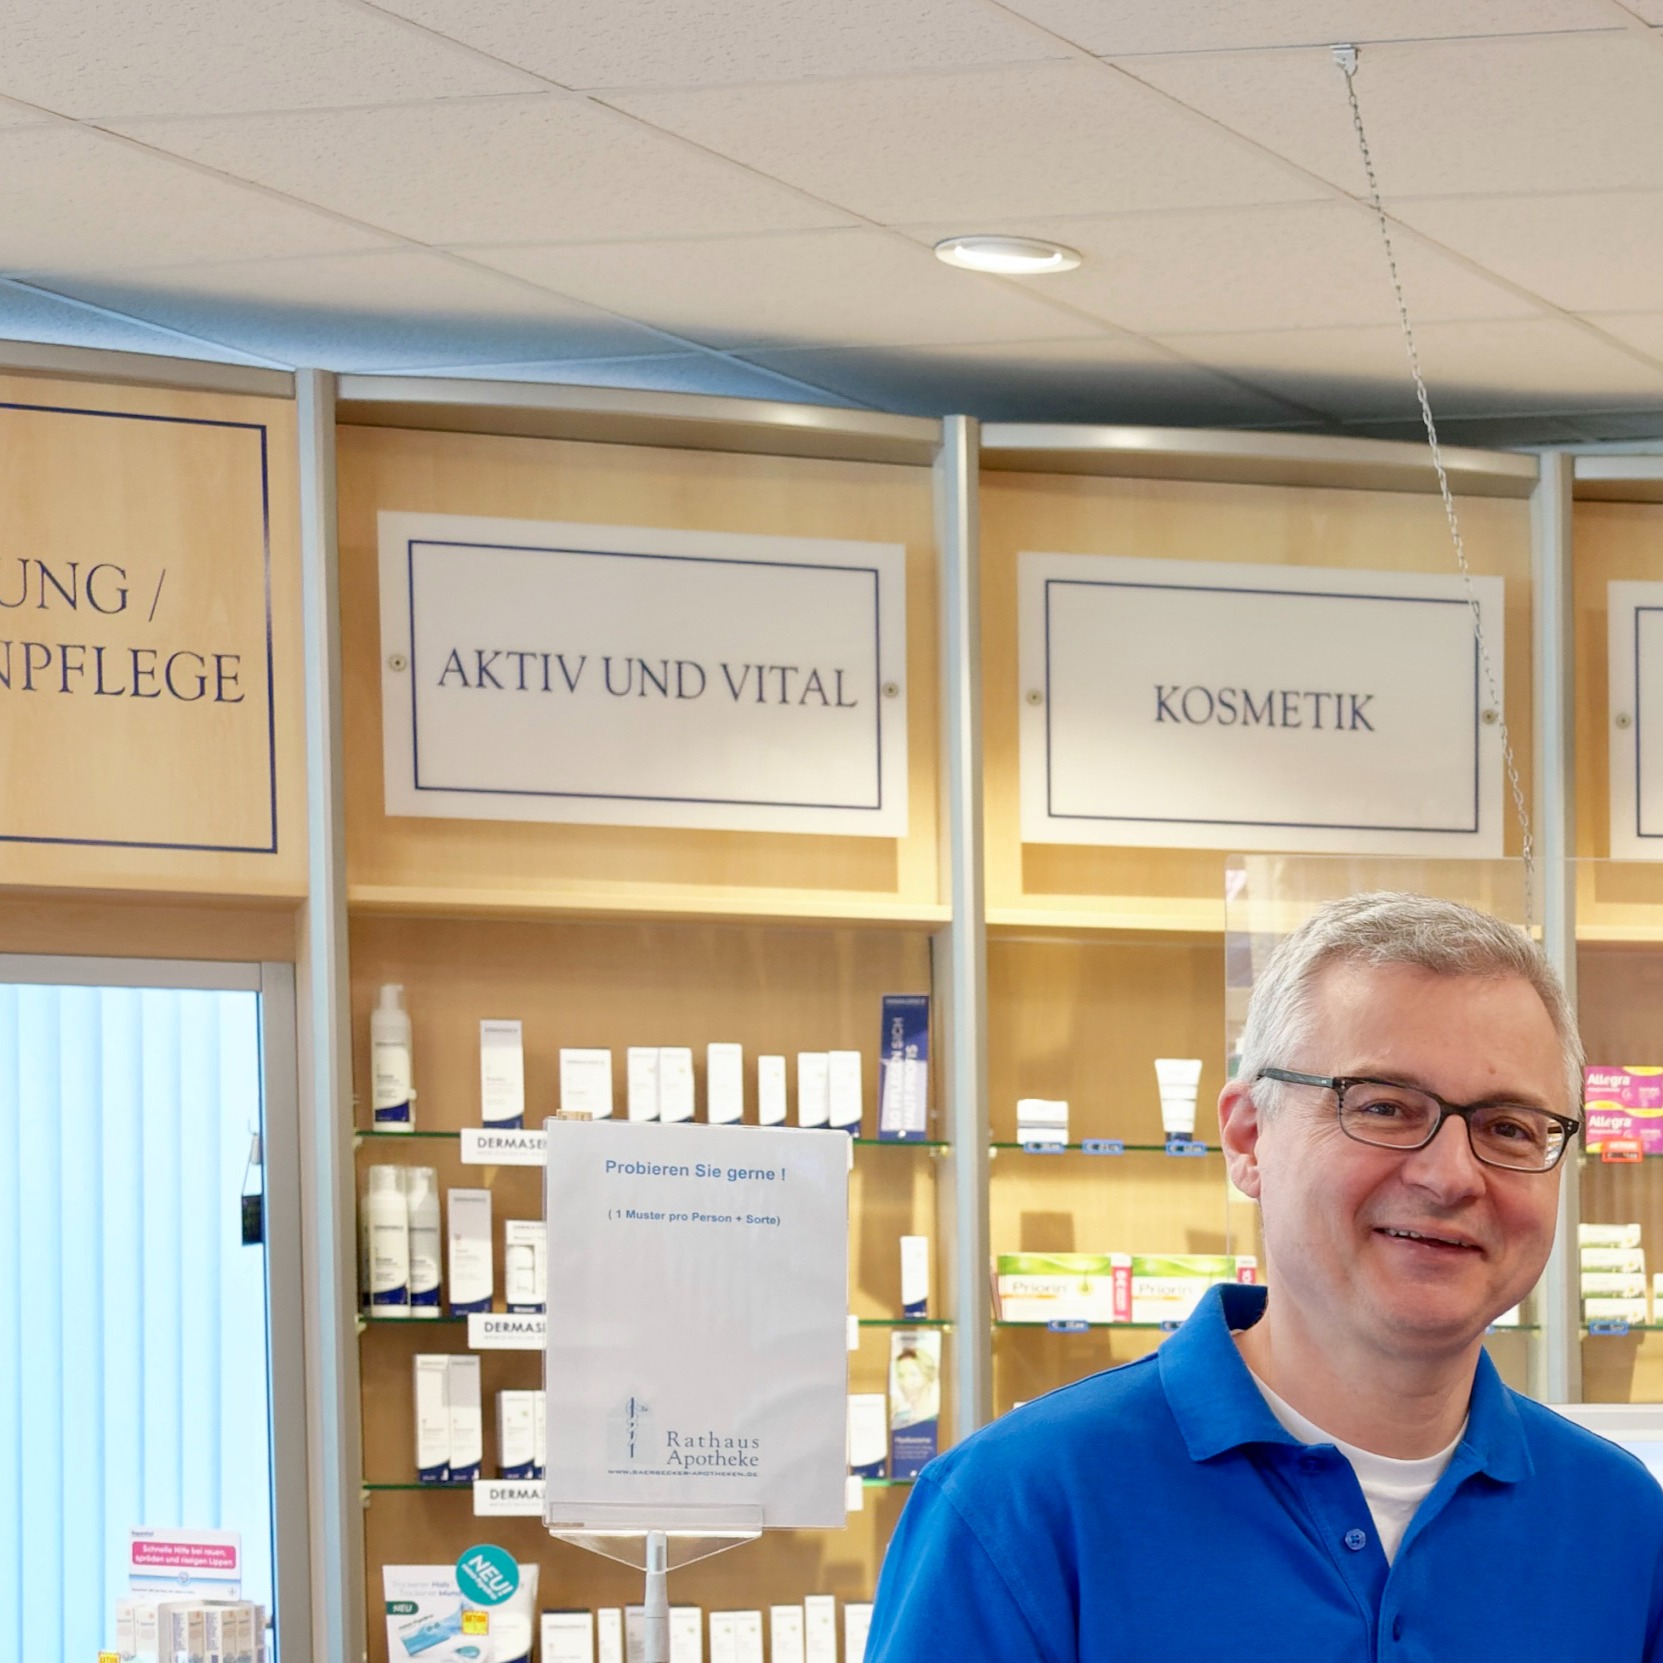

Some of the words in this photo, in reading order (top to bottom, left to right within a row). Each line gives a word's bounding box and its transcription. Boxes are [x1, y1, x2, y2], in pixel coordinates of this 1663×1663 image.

[437, 648, 588, 694] AKTIV
[603, 656, 707, 702] UND
[721, 664, 859, 709] VITAL
[1153, 684, 1376, 733] KOSMETIK
[605, 1159, 690, 1178] Probieren
[695, 1163, 722, 1179] Sie
[727, 1166, 776, 1183] gerne
[626, 1209, 666, 1222] Muster
[669, 1212, 689, 1224] pro
[692, 1211, 733, 1224] Person
[746, 1213, 782, 1227] Sorte)
[666, 1430, 761, 1450] Rathaus
[666, 1449, 761, 1470] Apotheke
